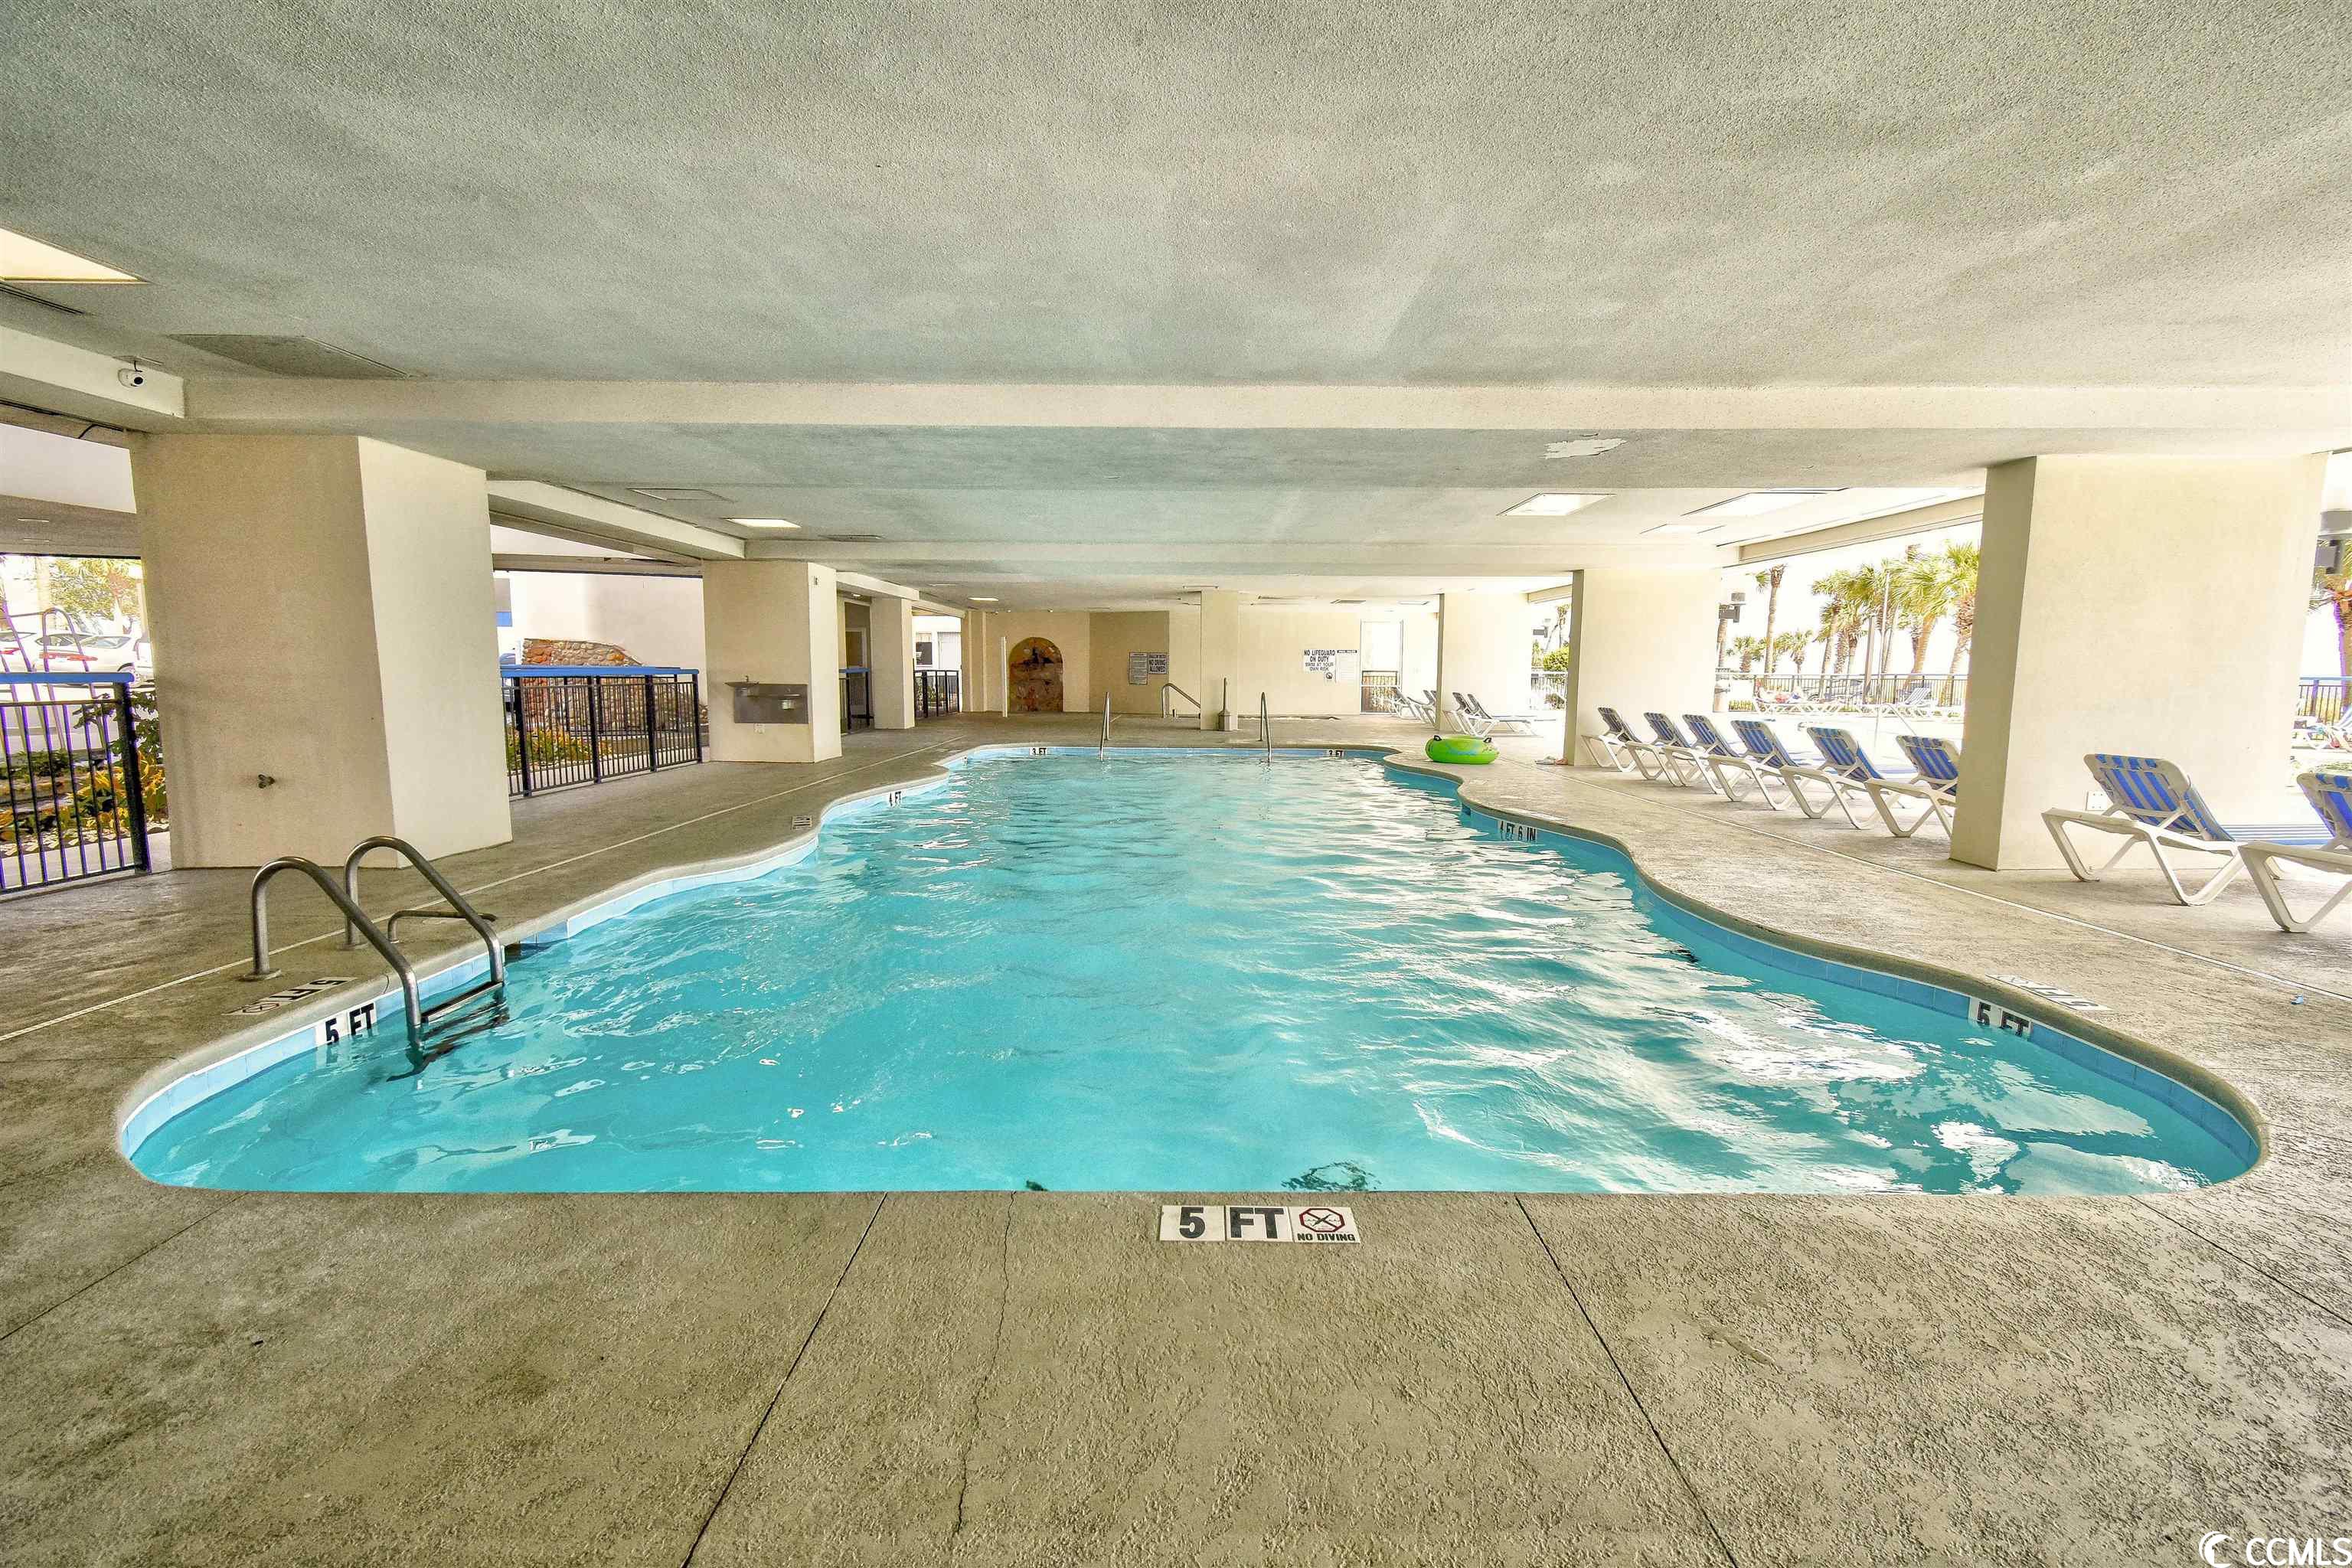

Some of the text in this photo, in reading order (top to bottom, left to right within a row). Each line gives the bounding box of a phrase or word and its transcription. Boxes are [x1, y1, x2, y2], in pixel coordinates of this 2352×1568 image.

[894, 791, 902, 803] FT
[1506, 822, 1515, 835] FT
[1518, 826, 1523, 840] 6
[1527, 827, 1536, 841] IN
[325, 1003, 374, 1045] 5 FT
[1976, 1001, 2030, 1037] 5 FT
[1179, 1207, 1285, 1240] 5 FT
[1297, 1233, 1356, 1242] NO DIVING
